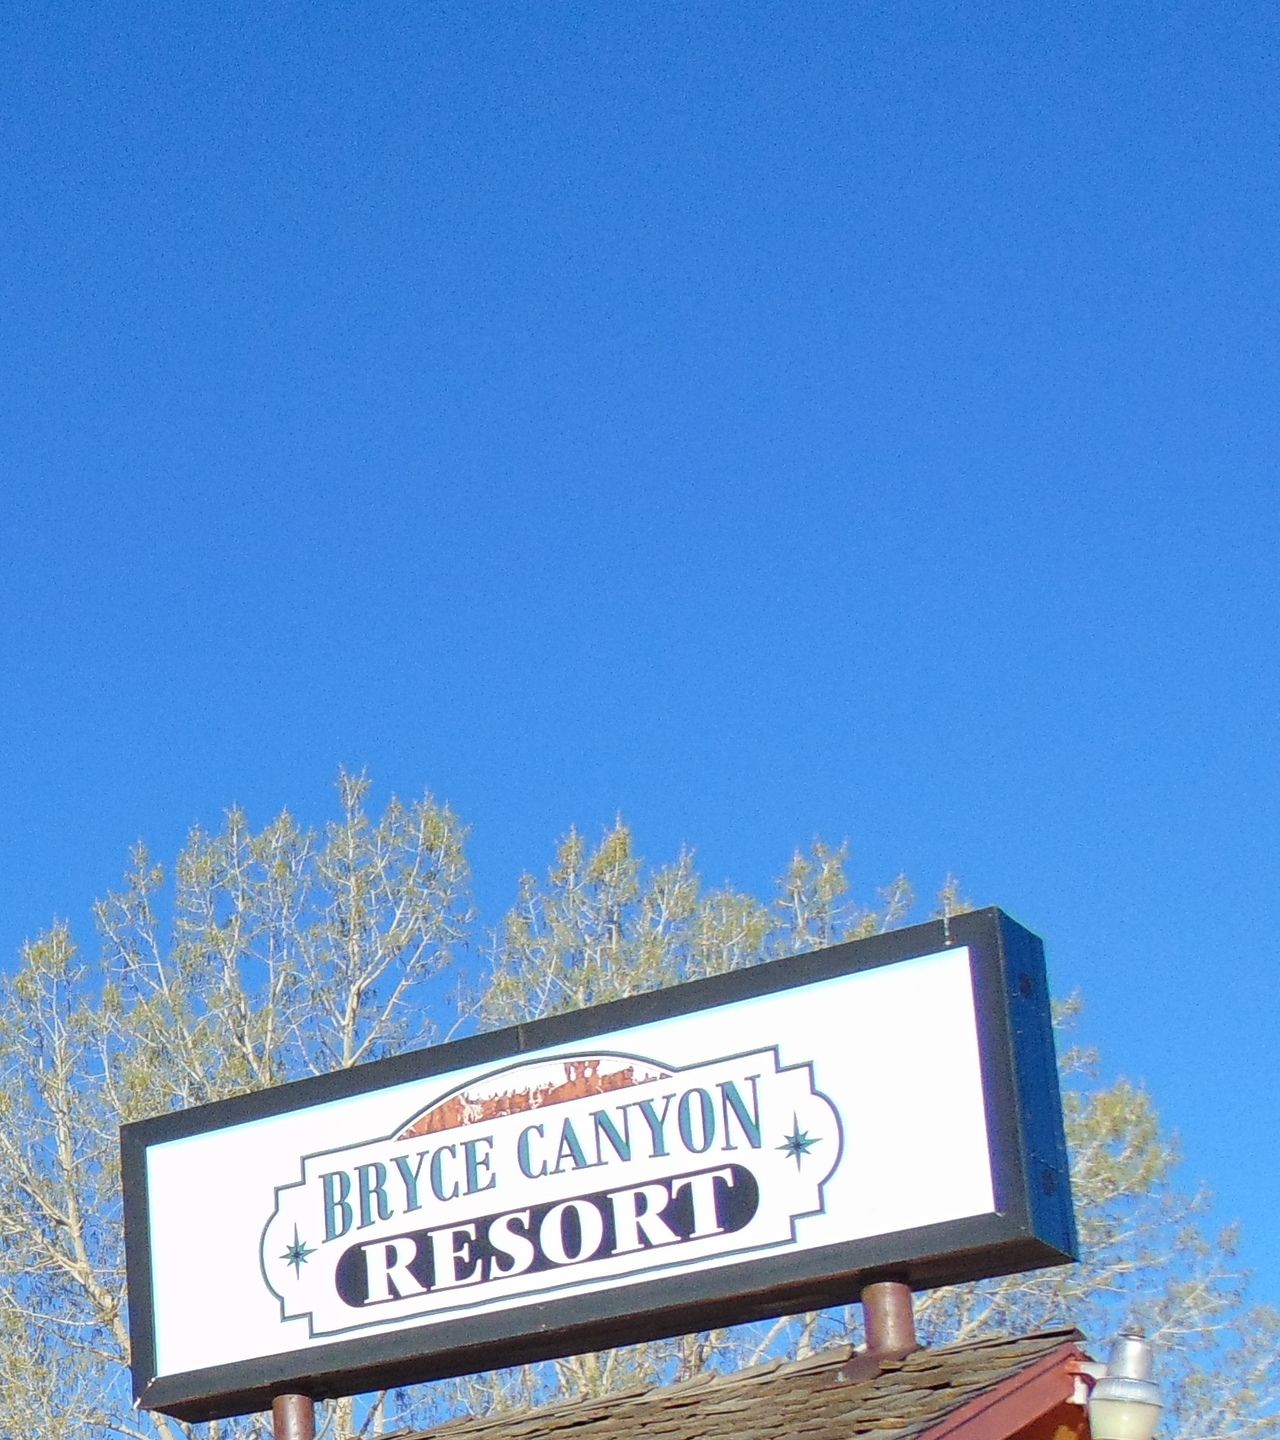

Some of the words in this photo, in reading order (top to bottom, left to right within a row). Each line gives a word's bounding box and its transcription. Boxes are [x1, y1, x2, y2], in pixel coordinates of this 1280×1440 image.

[319, 1135, 496, 1242] BRYCE
[516, 1073, 762, 1179] CANYON
[361, 1169, 735, 1304] RESORT
